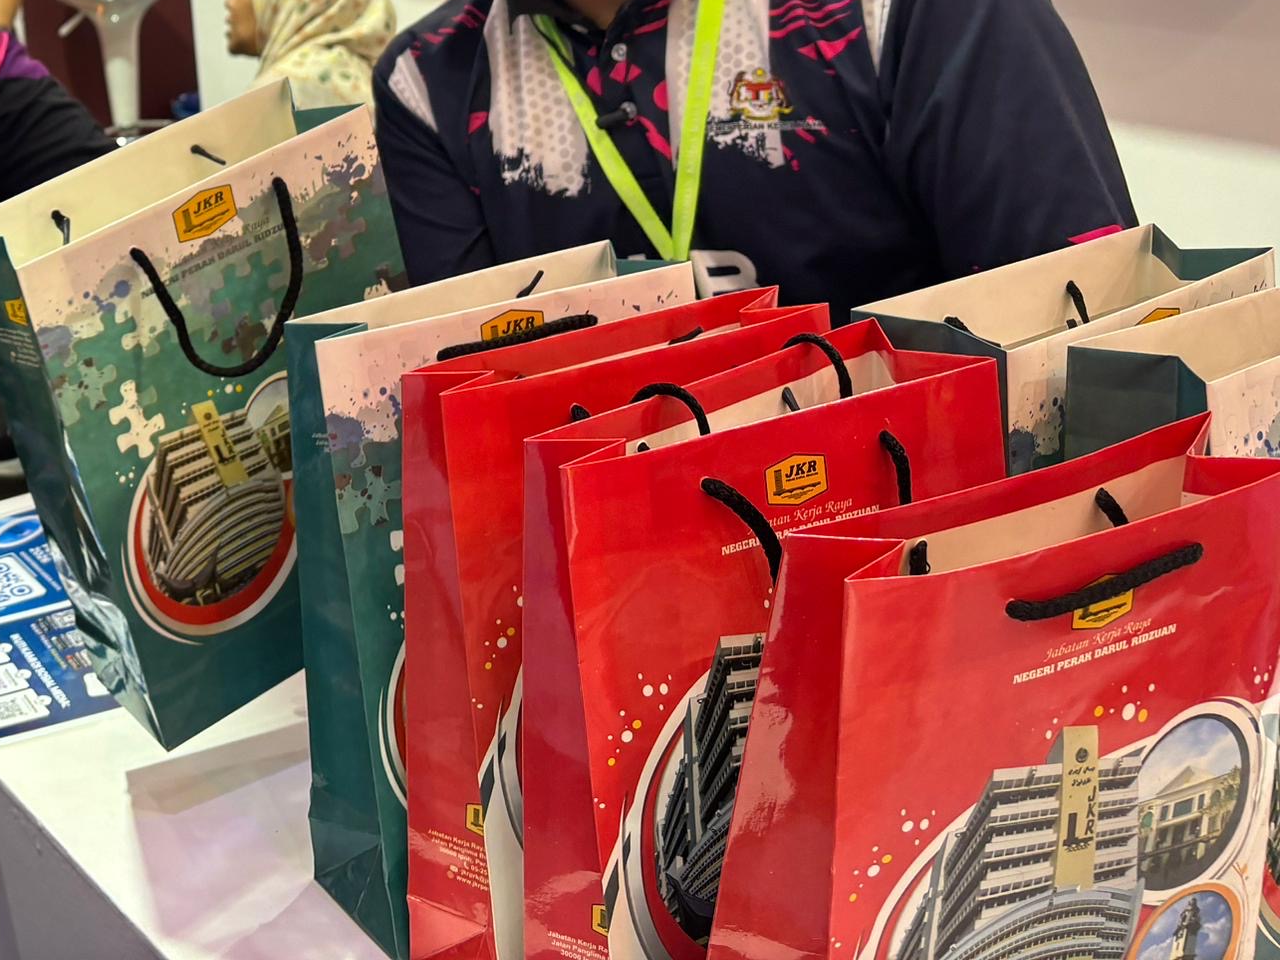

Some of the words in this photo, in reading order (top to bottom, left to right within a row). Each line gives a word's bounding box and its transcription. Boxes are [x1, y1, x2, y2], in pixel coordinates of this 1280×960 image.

[193, 191, 225, 215] JKR
[501, 315, 536, 335] JKR
[784, 460, 818, 479] JKR
[793, 504, 823, 524] Kerja
[824, 497, 854, 515] Raya
[1042, 638, 1090, 663] Jabatan
[1091, 630, 1123, 650] Kerja
[1122, 617, 1153, 637] Raya
[1012, 664, 1055, 685] NEGERI
[1056, 651, 1093, 673] PERAK
[1094, 638, 1130, 660] DARUL
[1130, 623, 1178, 648] RIDZUAN
[547, 930, 577, 943] Jabatan
[577, 937, 597, 950] Kerja
[551, 939, 572, 950] Jalan
